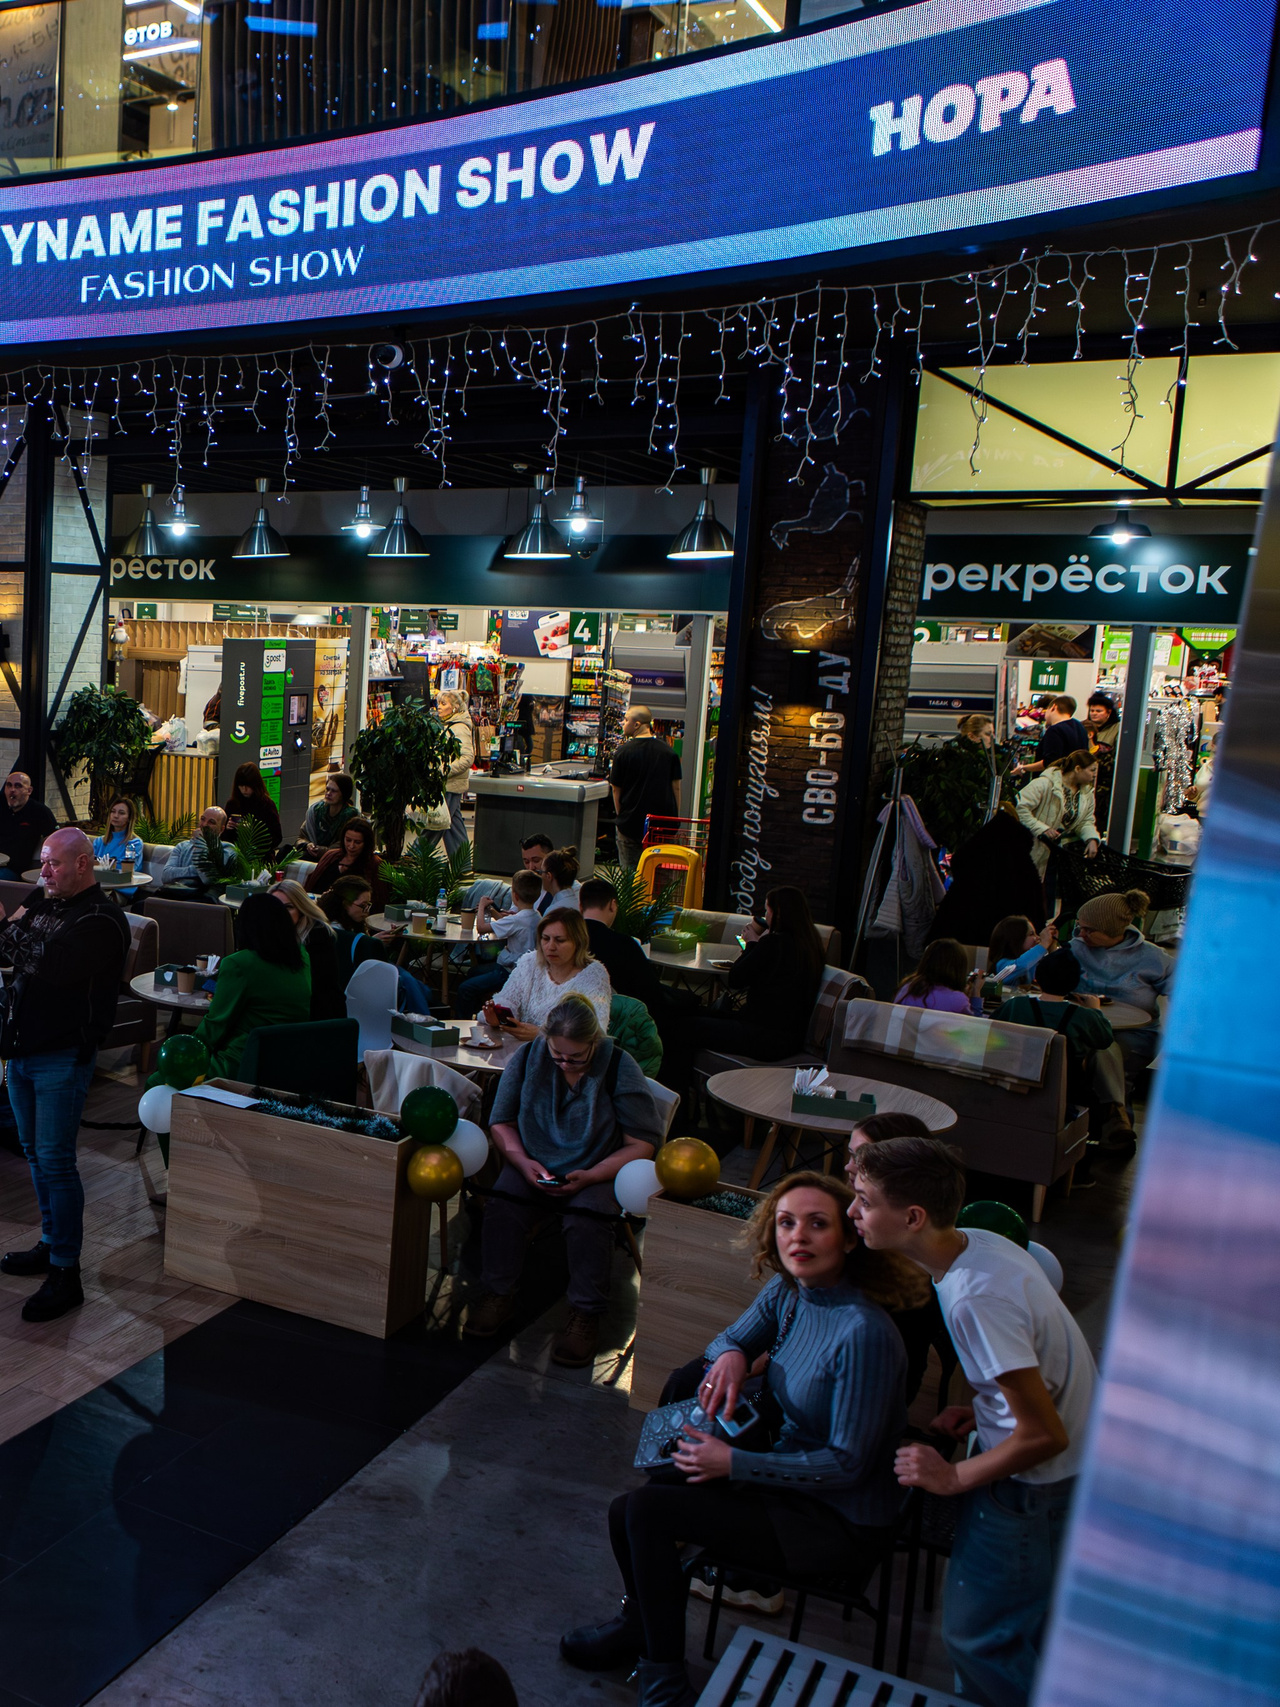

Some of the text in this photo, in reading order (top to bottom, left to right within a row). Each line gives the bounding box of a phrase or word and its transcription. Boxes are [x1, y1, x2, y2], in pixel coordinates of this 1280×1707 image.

[195, 164, 442, 247] FASHION
[455, 121, 657, 209] SHOW
[80, 244, 366, 303] FASHION SHOW
[109, 554, 216, 586] рёсток
[922, 554, 1232, 602] рекрёсток
[573, 618, 592, 642] 4
[237, 662, 246, 706] fivepost.ru
[234, 721, 246, 737] 5
[802, 650, 851, 825] СВО-БО-ДУ
[742, 684, 780, 843] попугаям!
